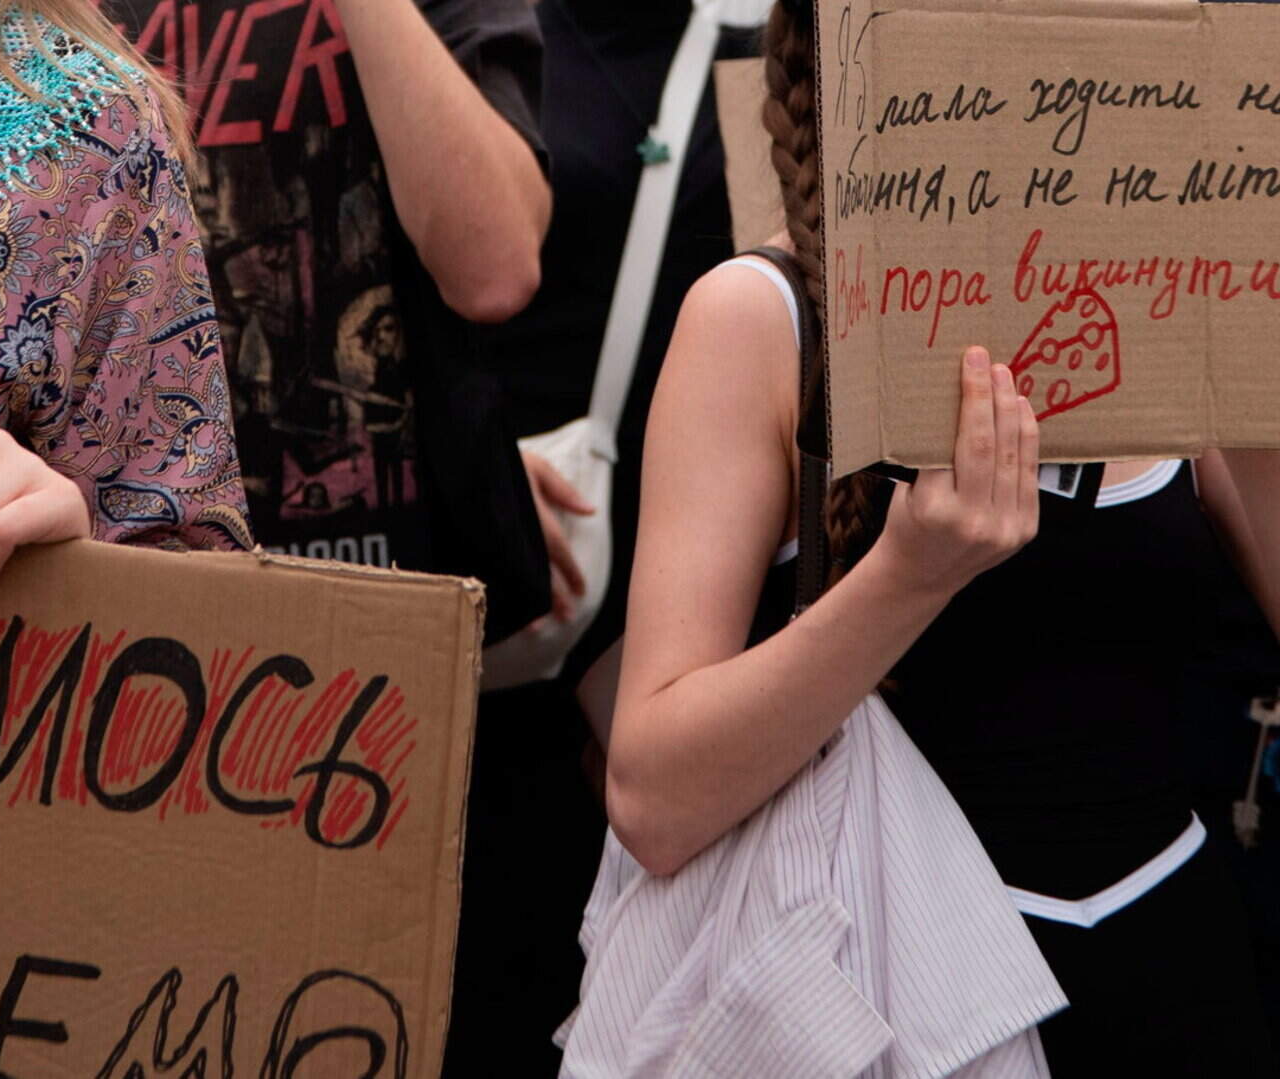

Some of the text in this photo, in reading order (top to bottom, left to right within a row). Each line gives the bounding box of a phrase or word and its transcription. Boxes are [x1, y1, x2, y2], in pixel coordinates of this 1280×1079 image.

[876, 83, 1008, 135] мала
[1023, 75, 1204, 155] ходити
[969, 169, 1001, 215] а
[1023, 164, 1079, 209] не
[1105, 164, 1161, 209] на
[881, 265, 993, 348] пора
